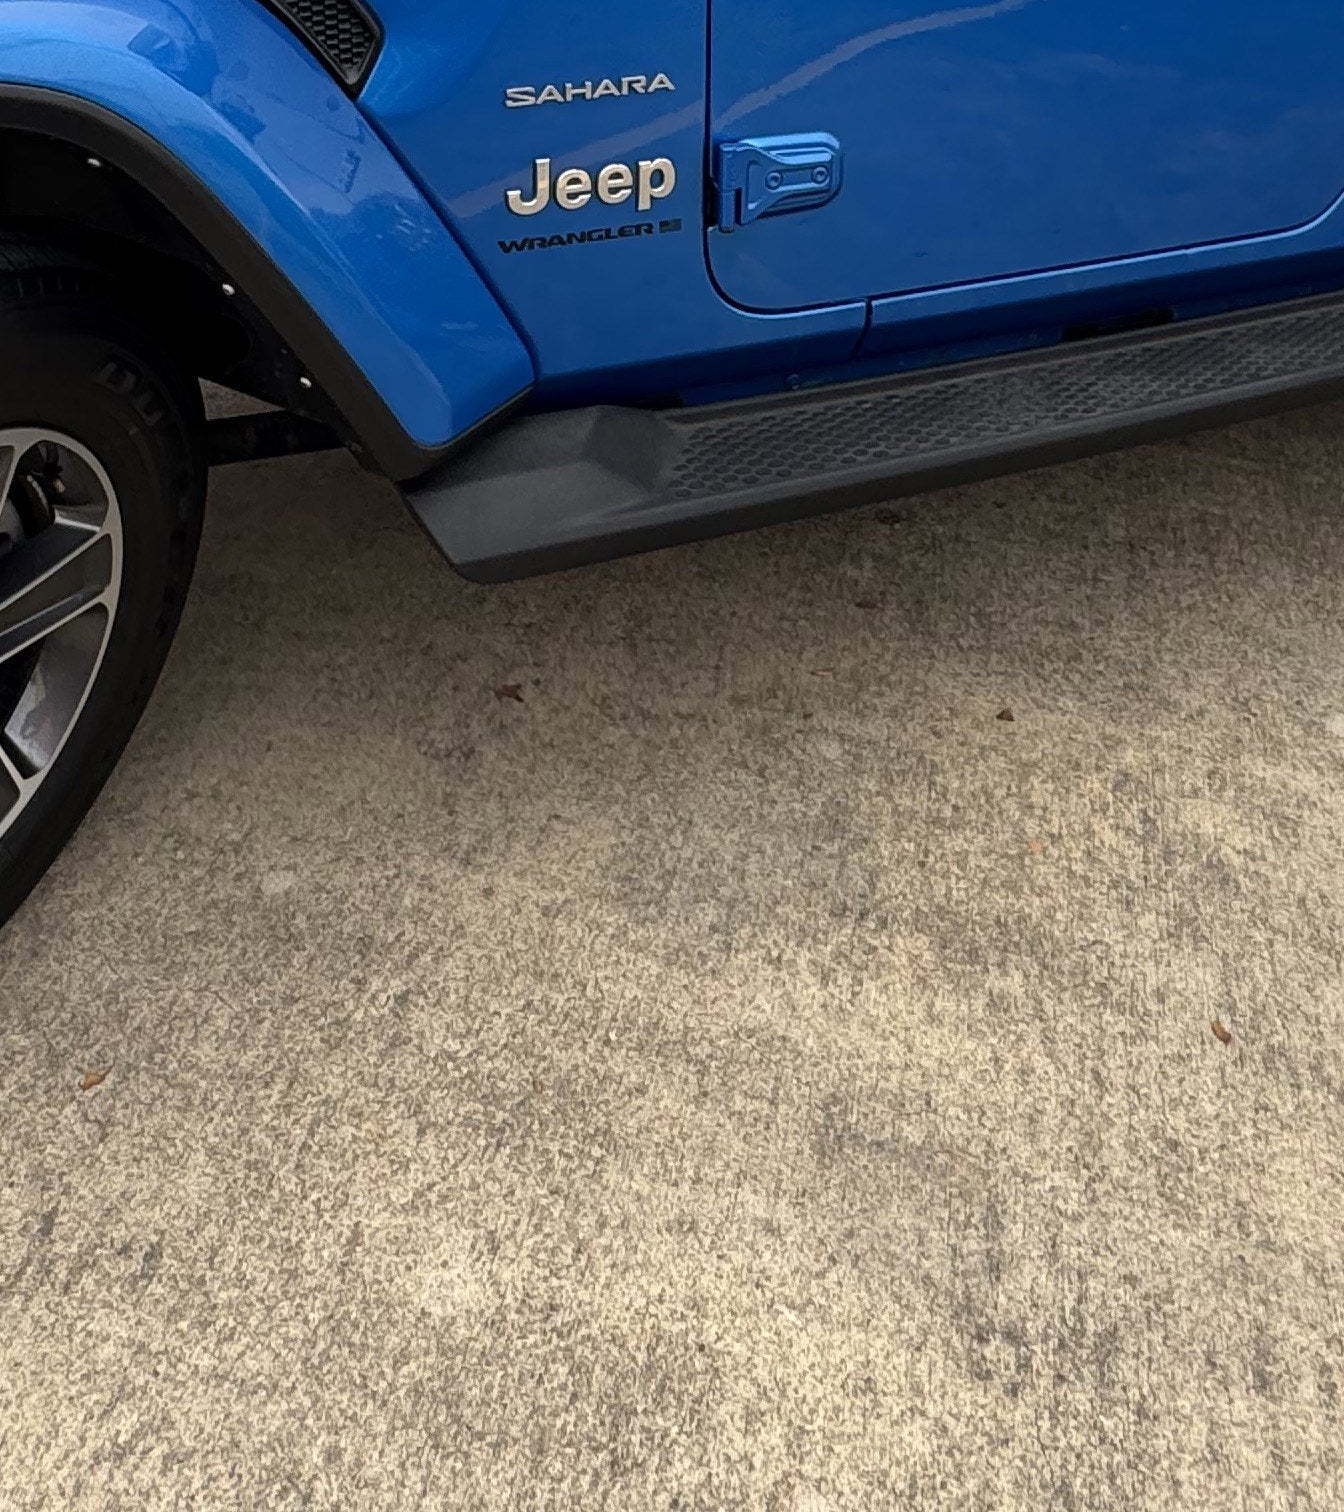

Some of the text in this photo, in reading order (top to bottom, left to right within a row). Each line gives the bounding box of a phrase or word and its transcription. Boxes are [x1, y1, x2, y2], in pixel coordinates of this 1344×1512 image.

[505, 72, 676, 108] SAHARA
[506, 157, 676, 216] Jeep
[497, 222, 654, 254] WRANGLER
